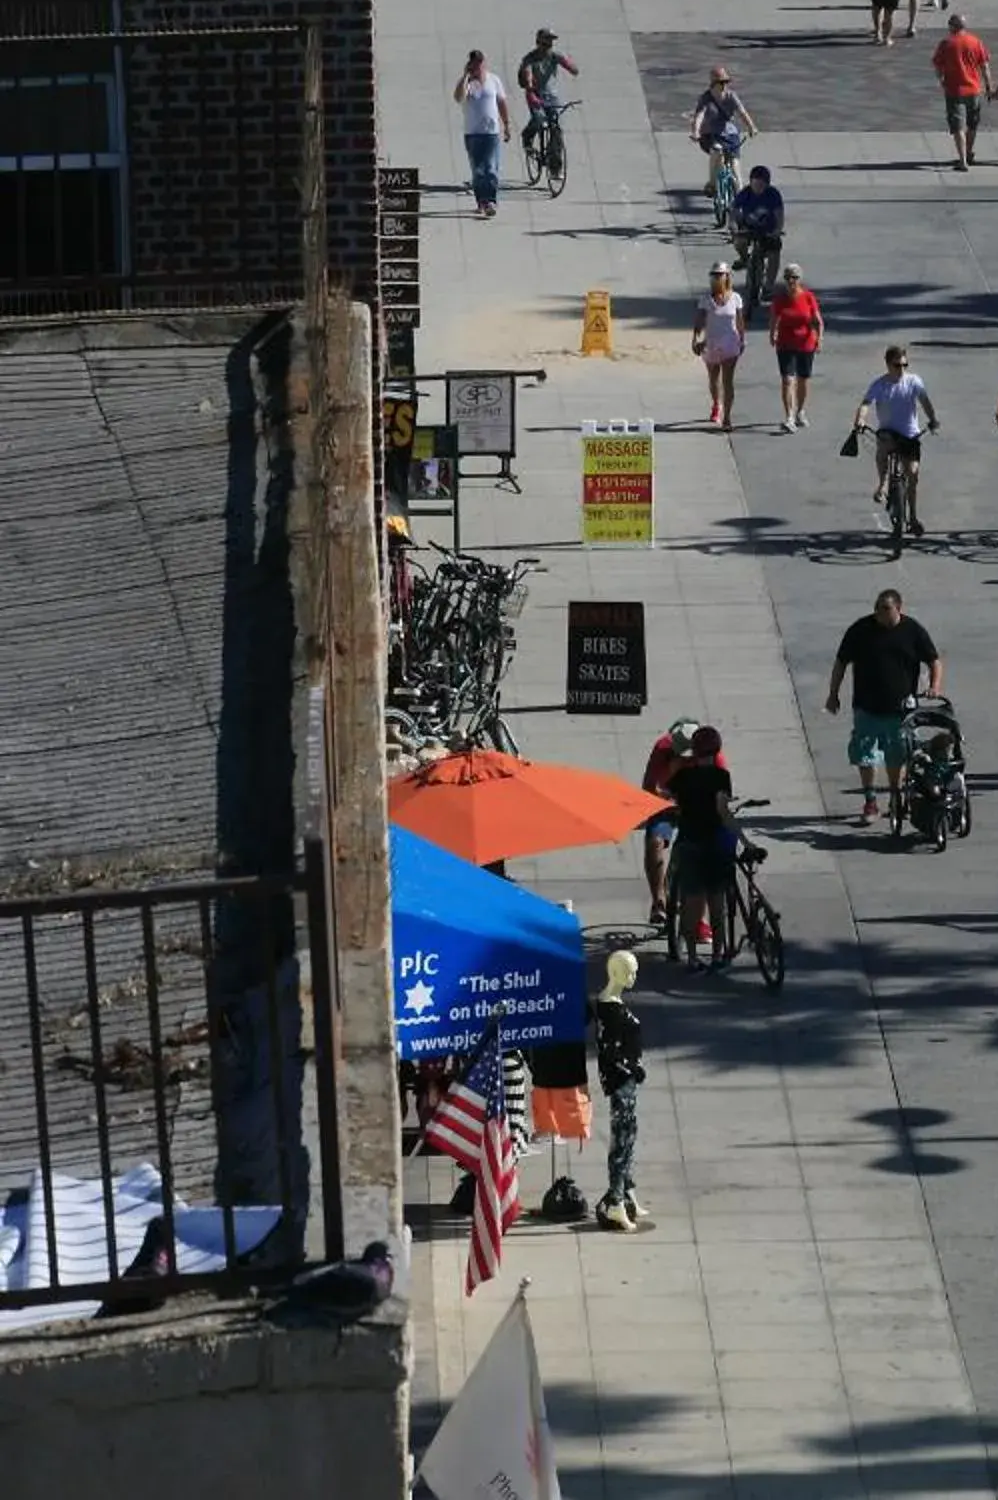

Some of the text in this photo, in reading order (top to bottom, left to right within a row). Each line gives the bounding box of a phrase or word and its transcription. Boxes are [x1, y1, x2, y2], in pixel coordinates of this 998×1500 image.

[586, 440, 649, 457] MASSAGE
[583, 637, 628, 655] BIKES
[578, 663, 631, 682] SKATES
[503, 969, 541, 990] Shul
[449, 1006, 471, 1021] on
